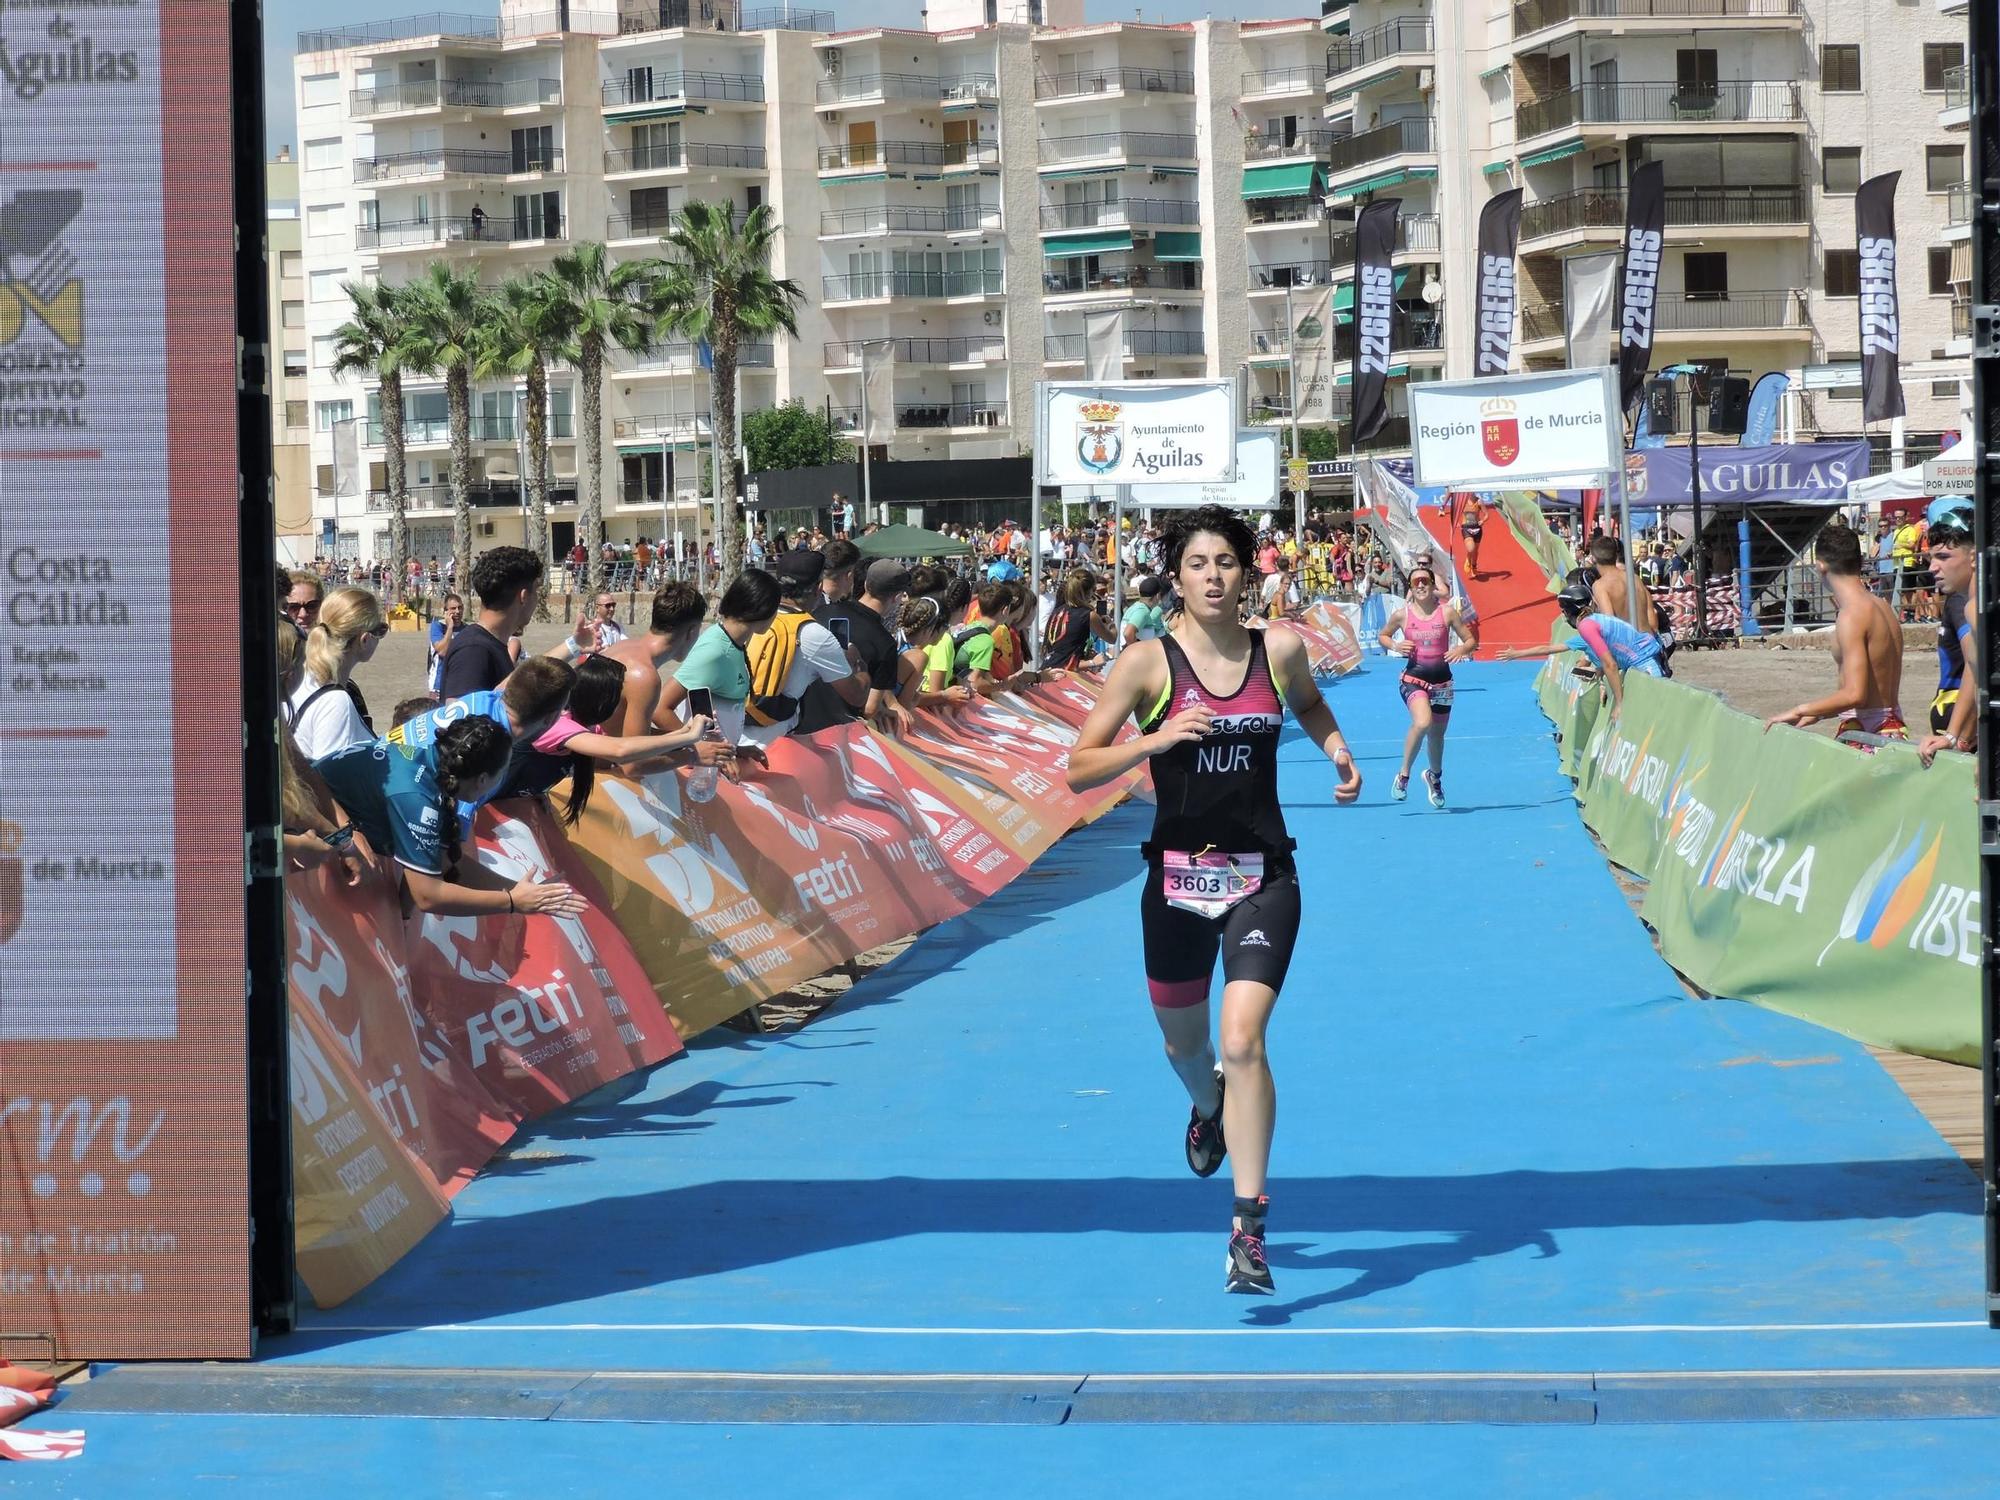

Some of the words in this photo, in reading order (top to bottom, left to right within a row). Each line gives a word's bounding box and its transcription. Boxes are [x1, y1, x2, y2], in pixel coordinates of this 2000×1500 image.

[48, 15, 75, 39] de
[1621, 228, 1661, 350] 226ERS
[1860, 237, 1898, 355] 226ERS
[1360, 265, 1392, 374] 226ERS
[1479, 254, 1514, 373] 226ERS
[1304, 399, 1323, 407] 1988
[0, 406, 86, 428] ICIPAL
[1420, 422, 1475, 441] Región
[1524, 415, 1544, 430] de
[1549, 411, 1603, 428] Murcia
[1131, 423, 1205, 439] Ayuntamiento
[1162, 437, 1175, 448] de
[1132, 447, 1204, 475] Águilas
[1317, 462, 1352, 473] CAFETE
[1937, 467, 1975, 476] PELIGRO
[1926, 480, 1943, 489] POR
[1946, 480, 1974, 489] AVENID
[8, 546, 113, 584] Costa
[9, 591, 130, 627] Cálida
[12, 646, 79, 667] Región
[12, 672, 36, 692] de
[41, 672, 107, 692] Murcia
[1200, 716, 1274, 737] stral
[1197, 745, 1252, 773] NUR
[32, 857, 67, 881] de
[74, 855, 166, 881] Murcia
[793, 851, 865, 913] Fetri
[1170, 874, 1221, 893] 3603
[707, 922, 775, 963] DEPORTIVO
[724, 945, 793, 988] MUNICIPAL
[466, 968, 584, 1070] Fetri
